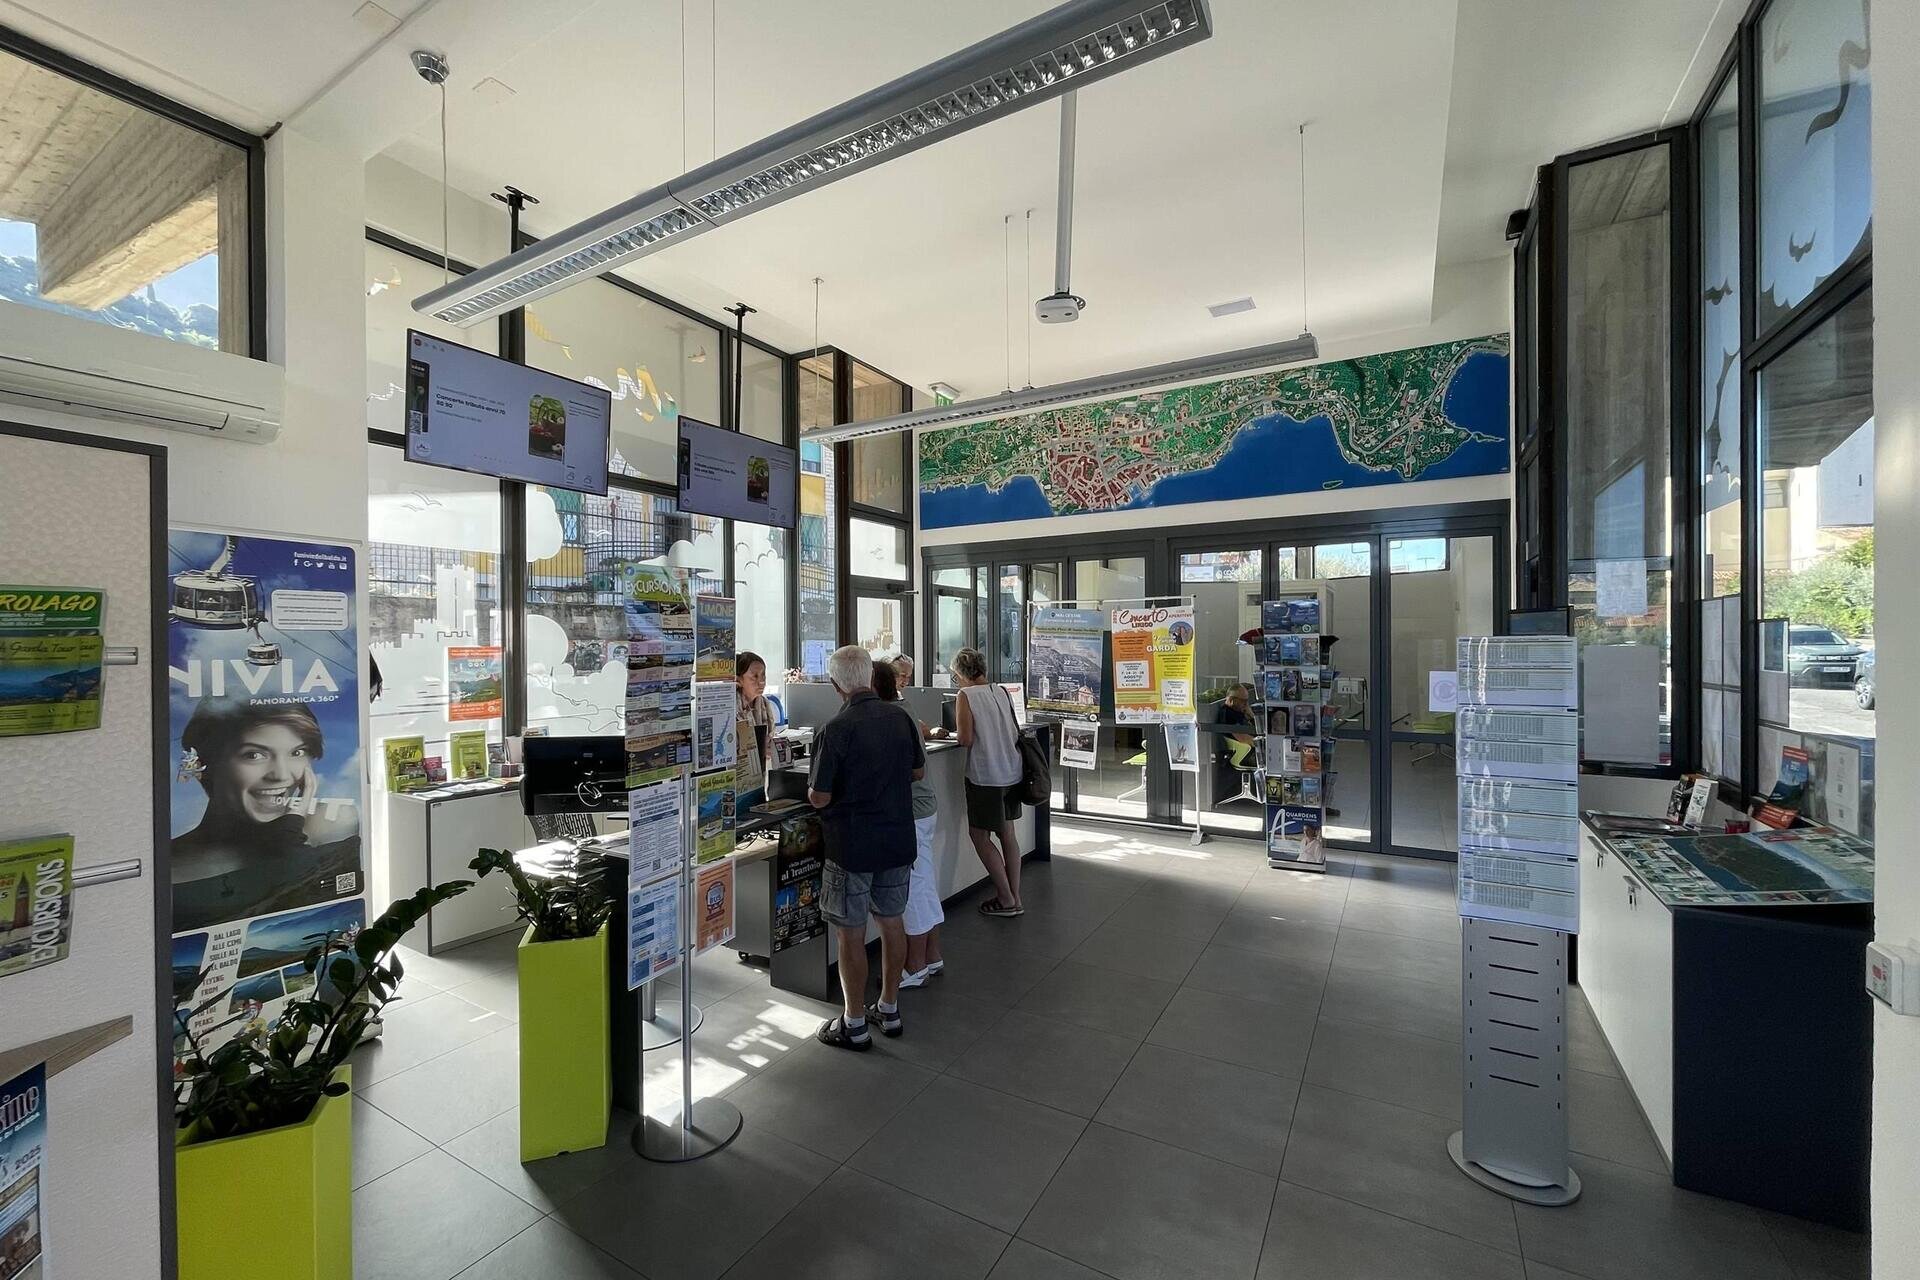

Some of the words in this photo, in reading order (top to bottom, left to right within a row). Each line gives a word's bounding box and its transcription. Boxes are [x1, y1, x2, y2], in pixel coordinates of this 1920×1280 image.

[624, 579, 682, 596] EXCURSIONS
[1119, 608, 1169, 625] Concerto
[1146, 644, 1178, 653] GARDA
[250, 697, 316, 706] PANORAMICA
[31, 858, 65, 964] EXCURSIONS
[203, 974, 224, 987] FLYING
[201, 986, 218, 997] FROM
[194, 1016, 214, 1028] PEAKS
